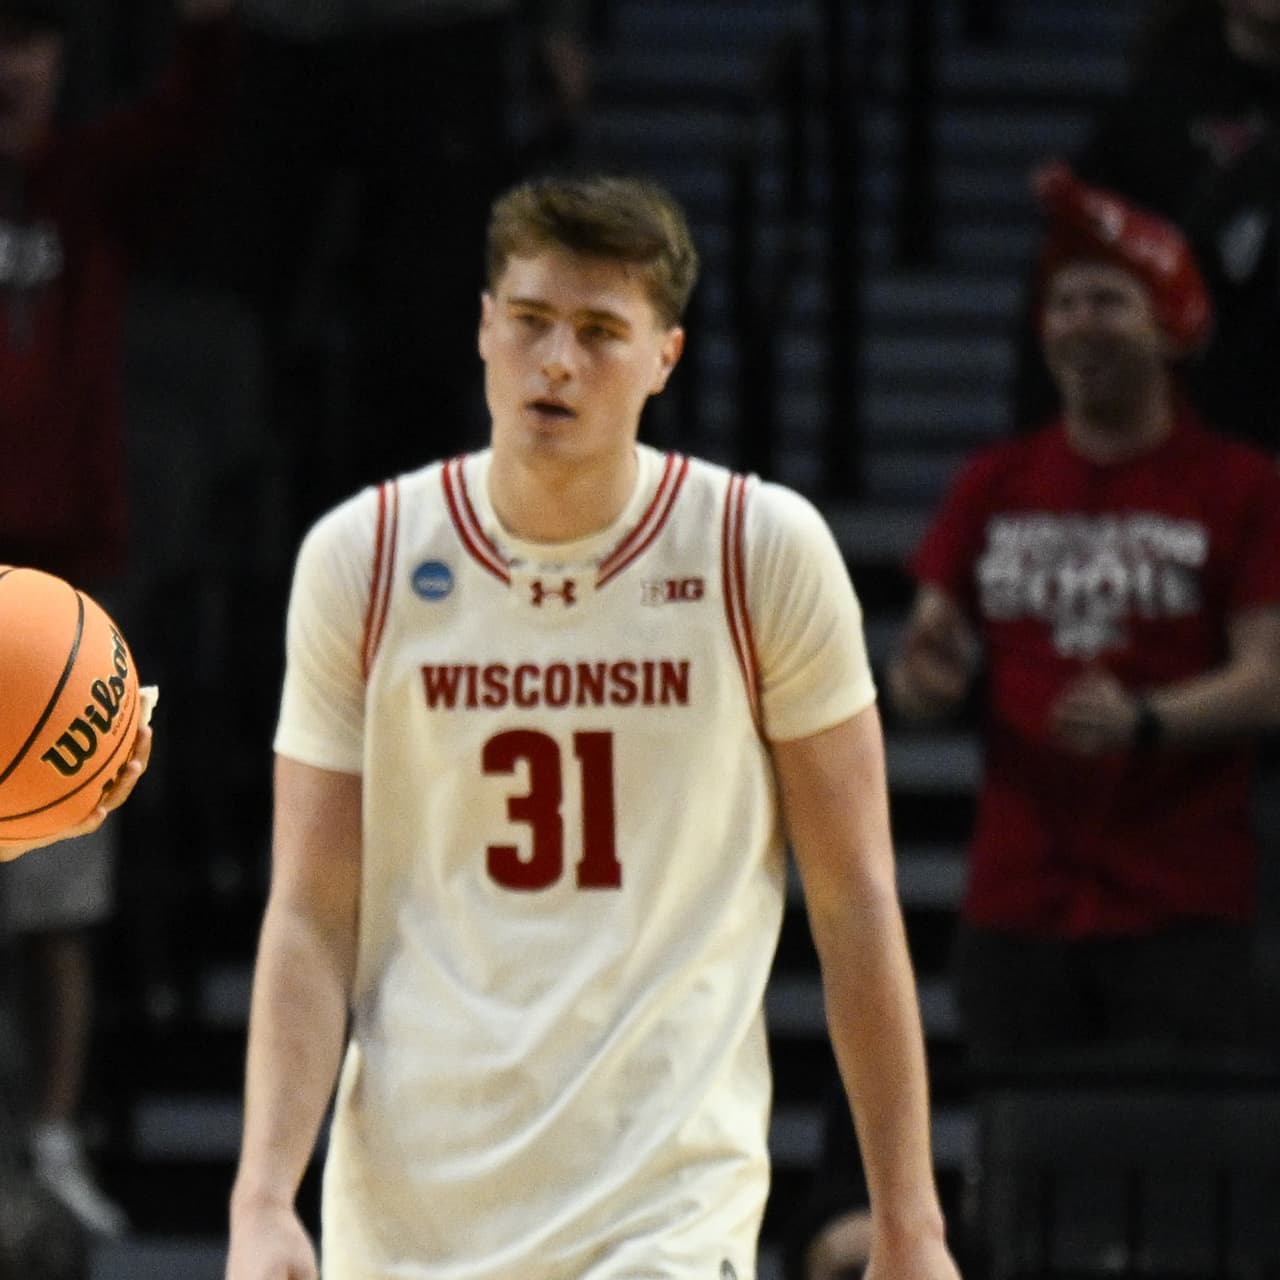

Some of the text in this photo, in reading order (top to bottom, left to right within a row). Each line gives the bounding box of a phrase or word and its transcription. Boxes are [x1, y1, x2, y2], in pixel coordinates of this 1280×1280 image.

[40, 624, 129, 777] Wilson
[420, 659, 689, 711] WISCONSIN
[481, 728, 622, 891] 31
